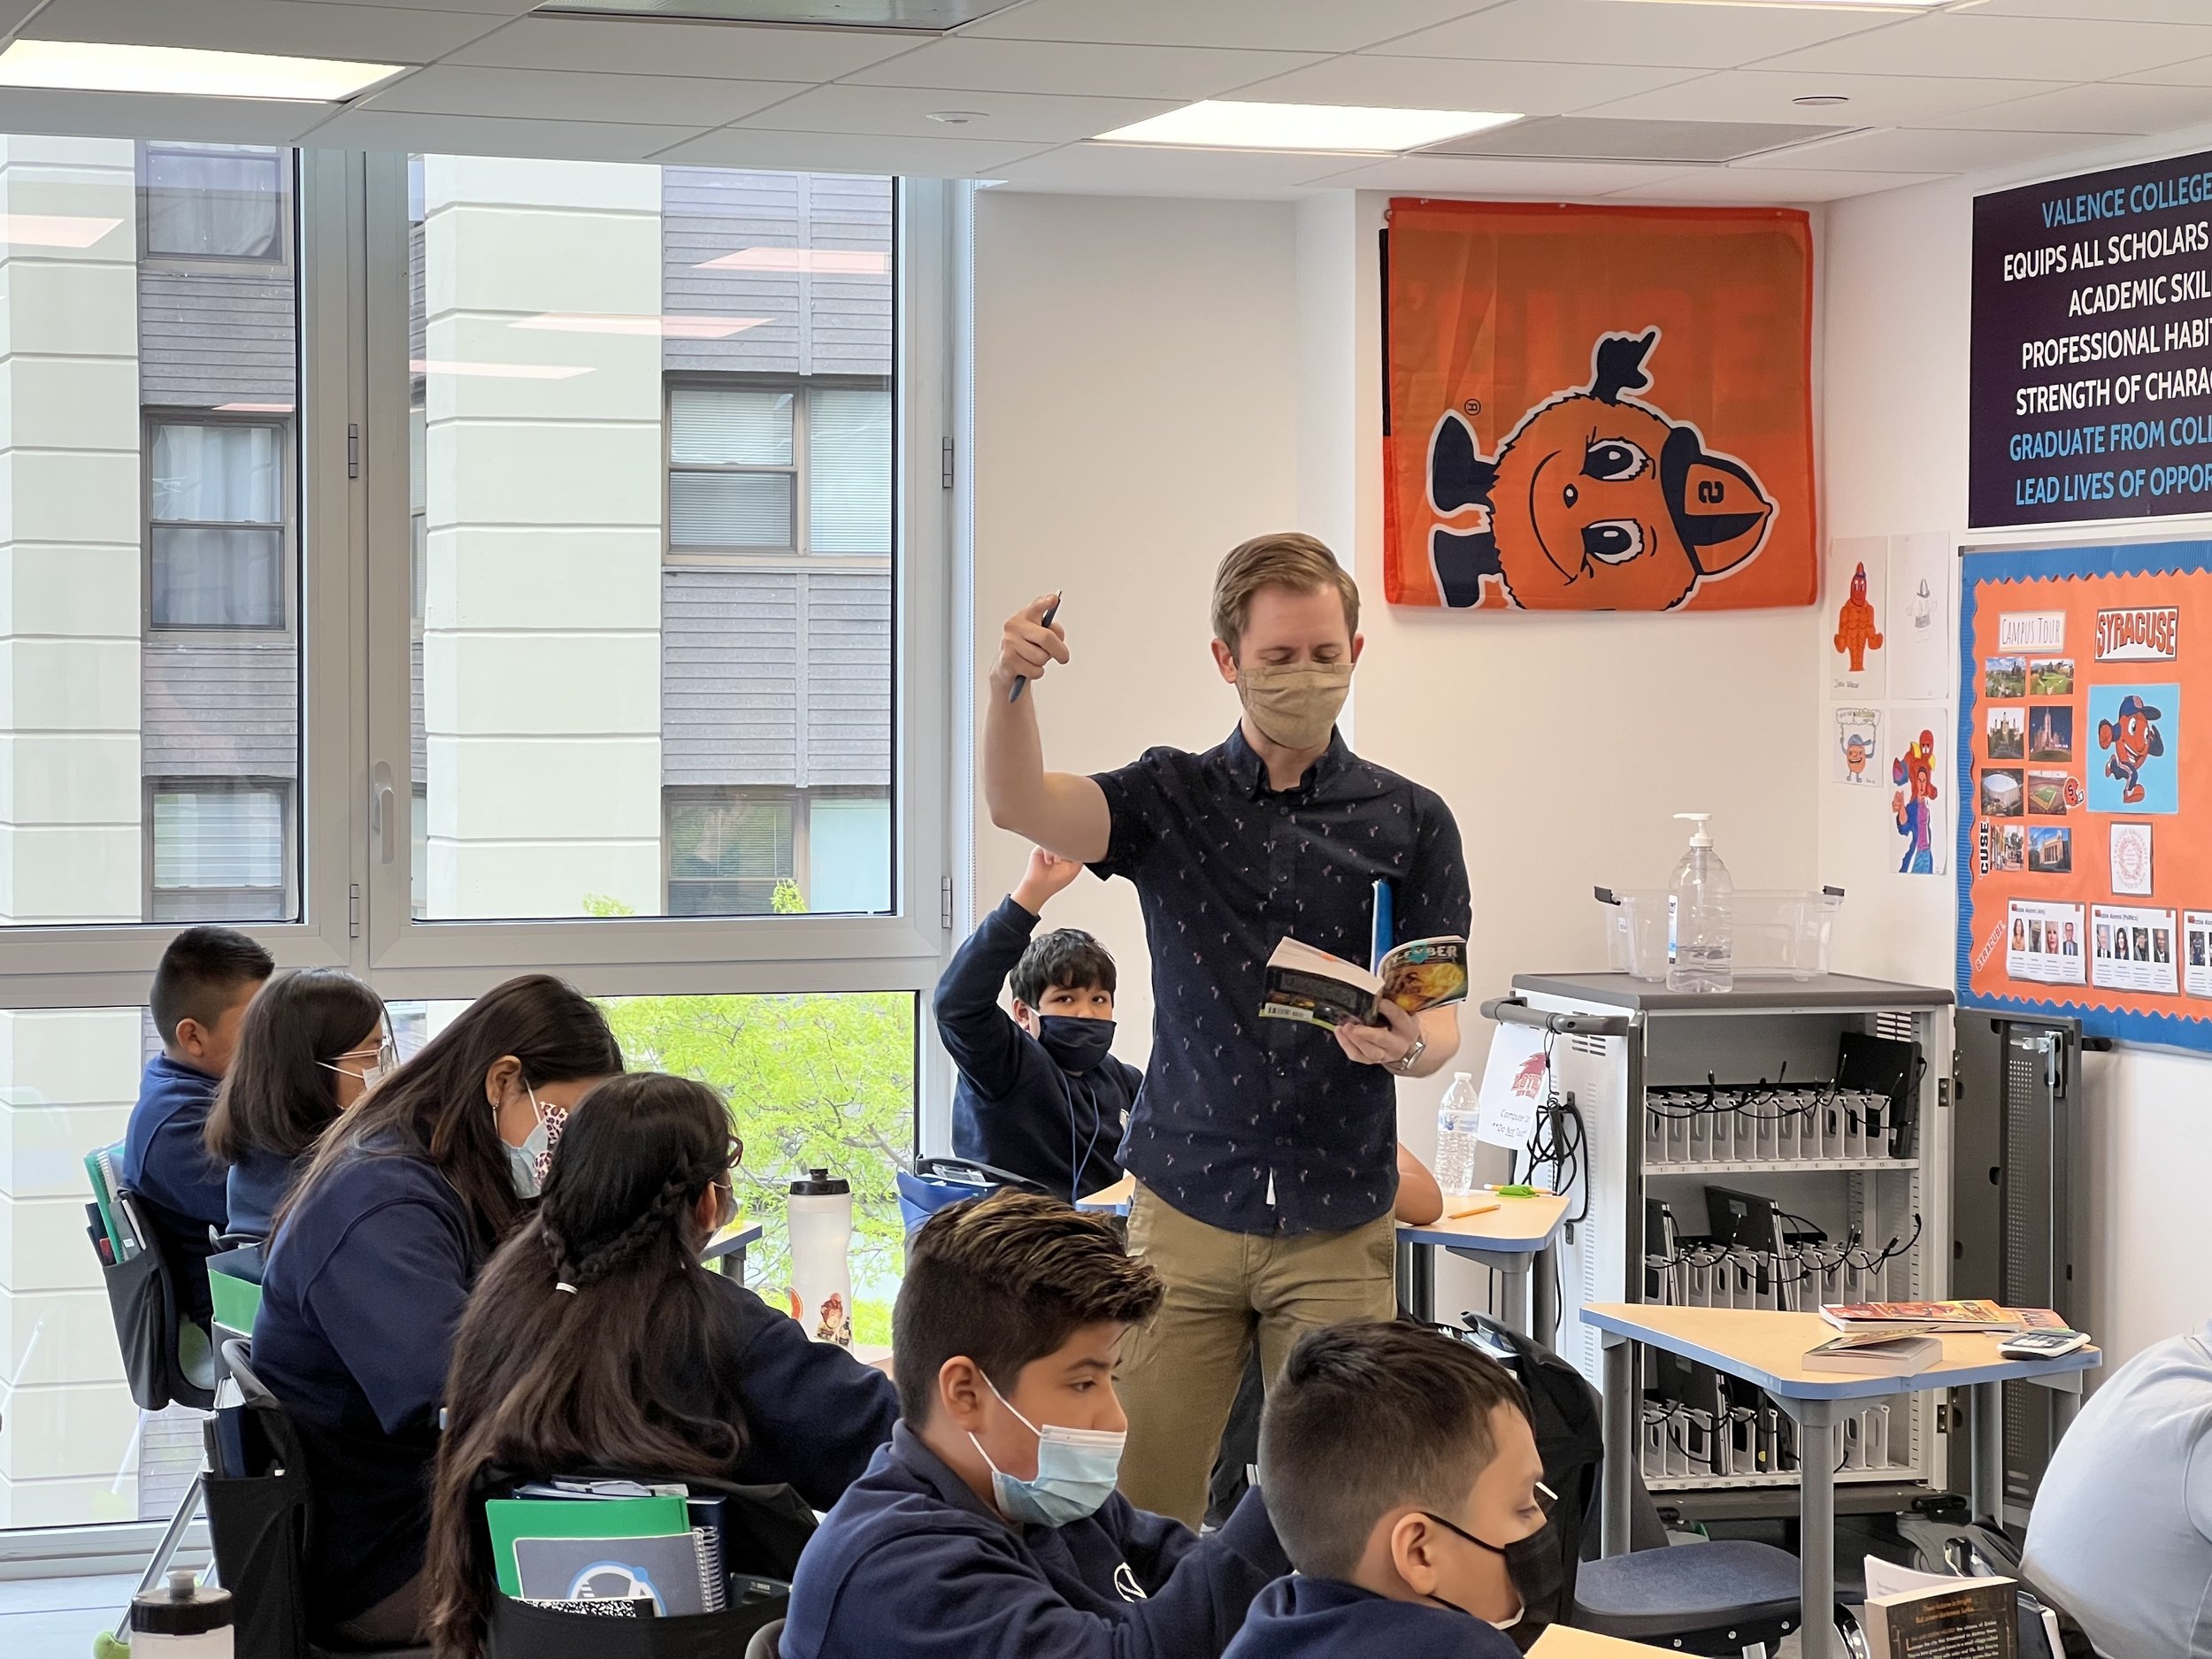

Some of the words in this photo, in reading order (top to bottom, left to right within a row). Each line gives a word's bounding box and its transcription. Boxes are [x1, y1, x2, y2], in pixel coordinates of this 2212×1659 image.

[2042, 188, 2124, 228] VALENCE
[2130, 172, 2212, 213] COLLEGE
[2003, 244, 2067, 281] EQUIPS
[2070, 239, 2104, 271] ALL
[2108, 221, 2209, 265] SCHOLARS
[2069, 276, 2167, 318] ACADEMIC
[2170, 269, 2212, 303] SKIL
[2022, 326, 2160, 370] PROFESSIONAL
[2016, 378, 2110, 416] STRENGTH
[2115, 374, 2142, 405] OF
[2145, 367, 2212, 401] CHARA
[2009, 426, 2105, 461] GRADUATE
[2110, 420, 2164, 455] FROM
[2016, 476, 2060, 505] LEAD
[2064, 471, 2114, 501] LIVES
[2119, 469, 2146, 497] OF
[2002, 618, 2034, 644] CAMPUS
[2038, 618, 2061, 643] TOUR
[2096, 611, 2177, 657] SYRACUSE
[1976, 921, 2004, 971] SYRACUSE
